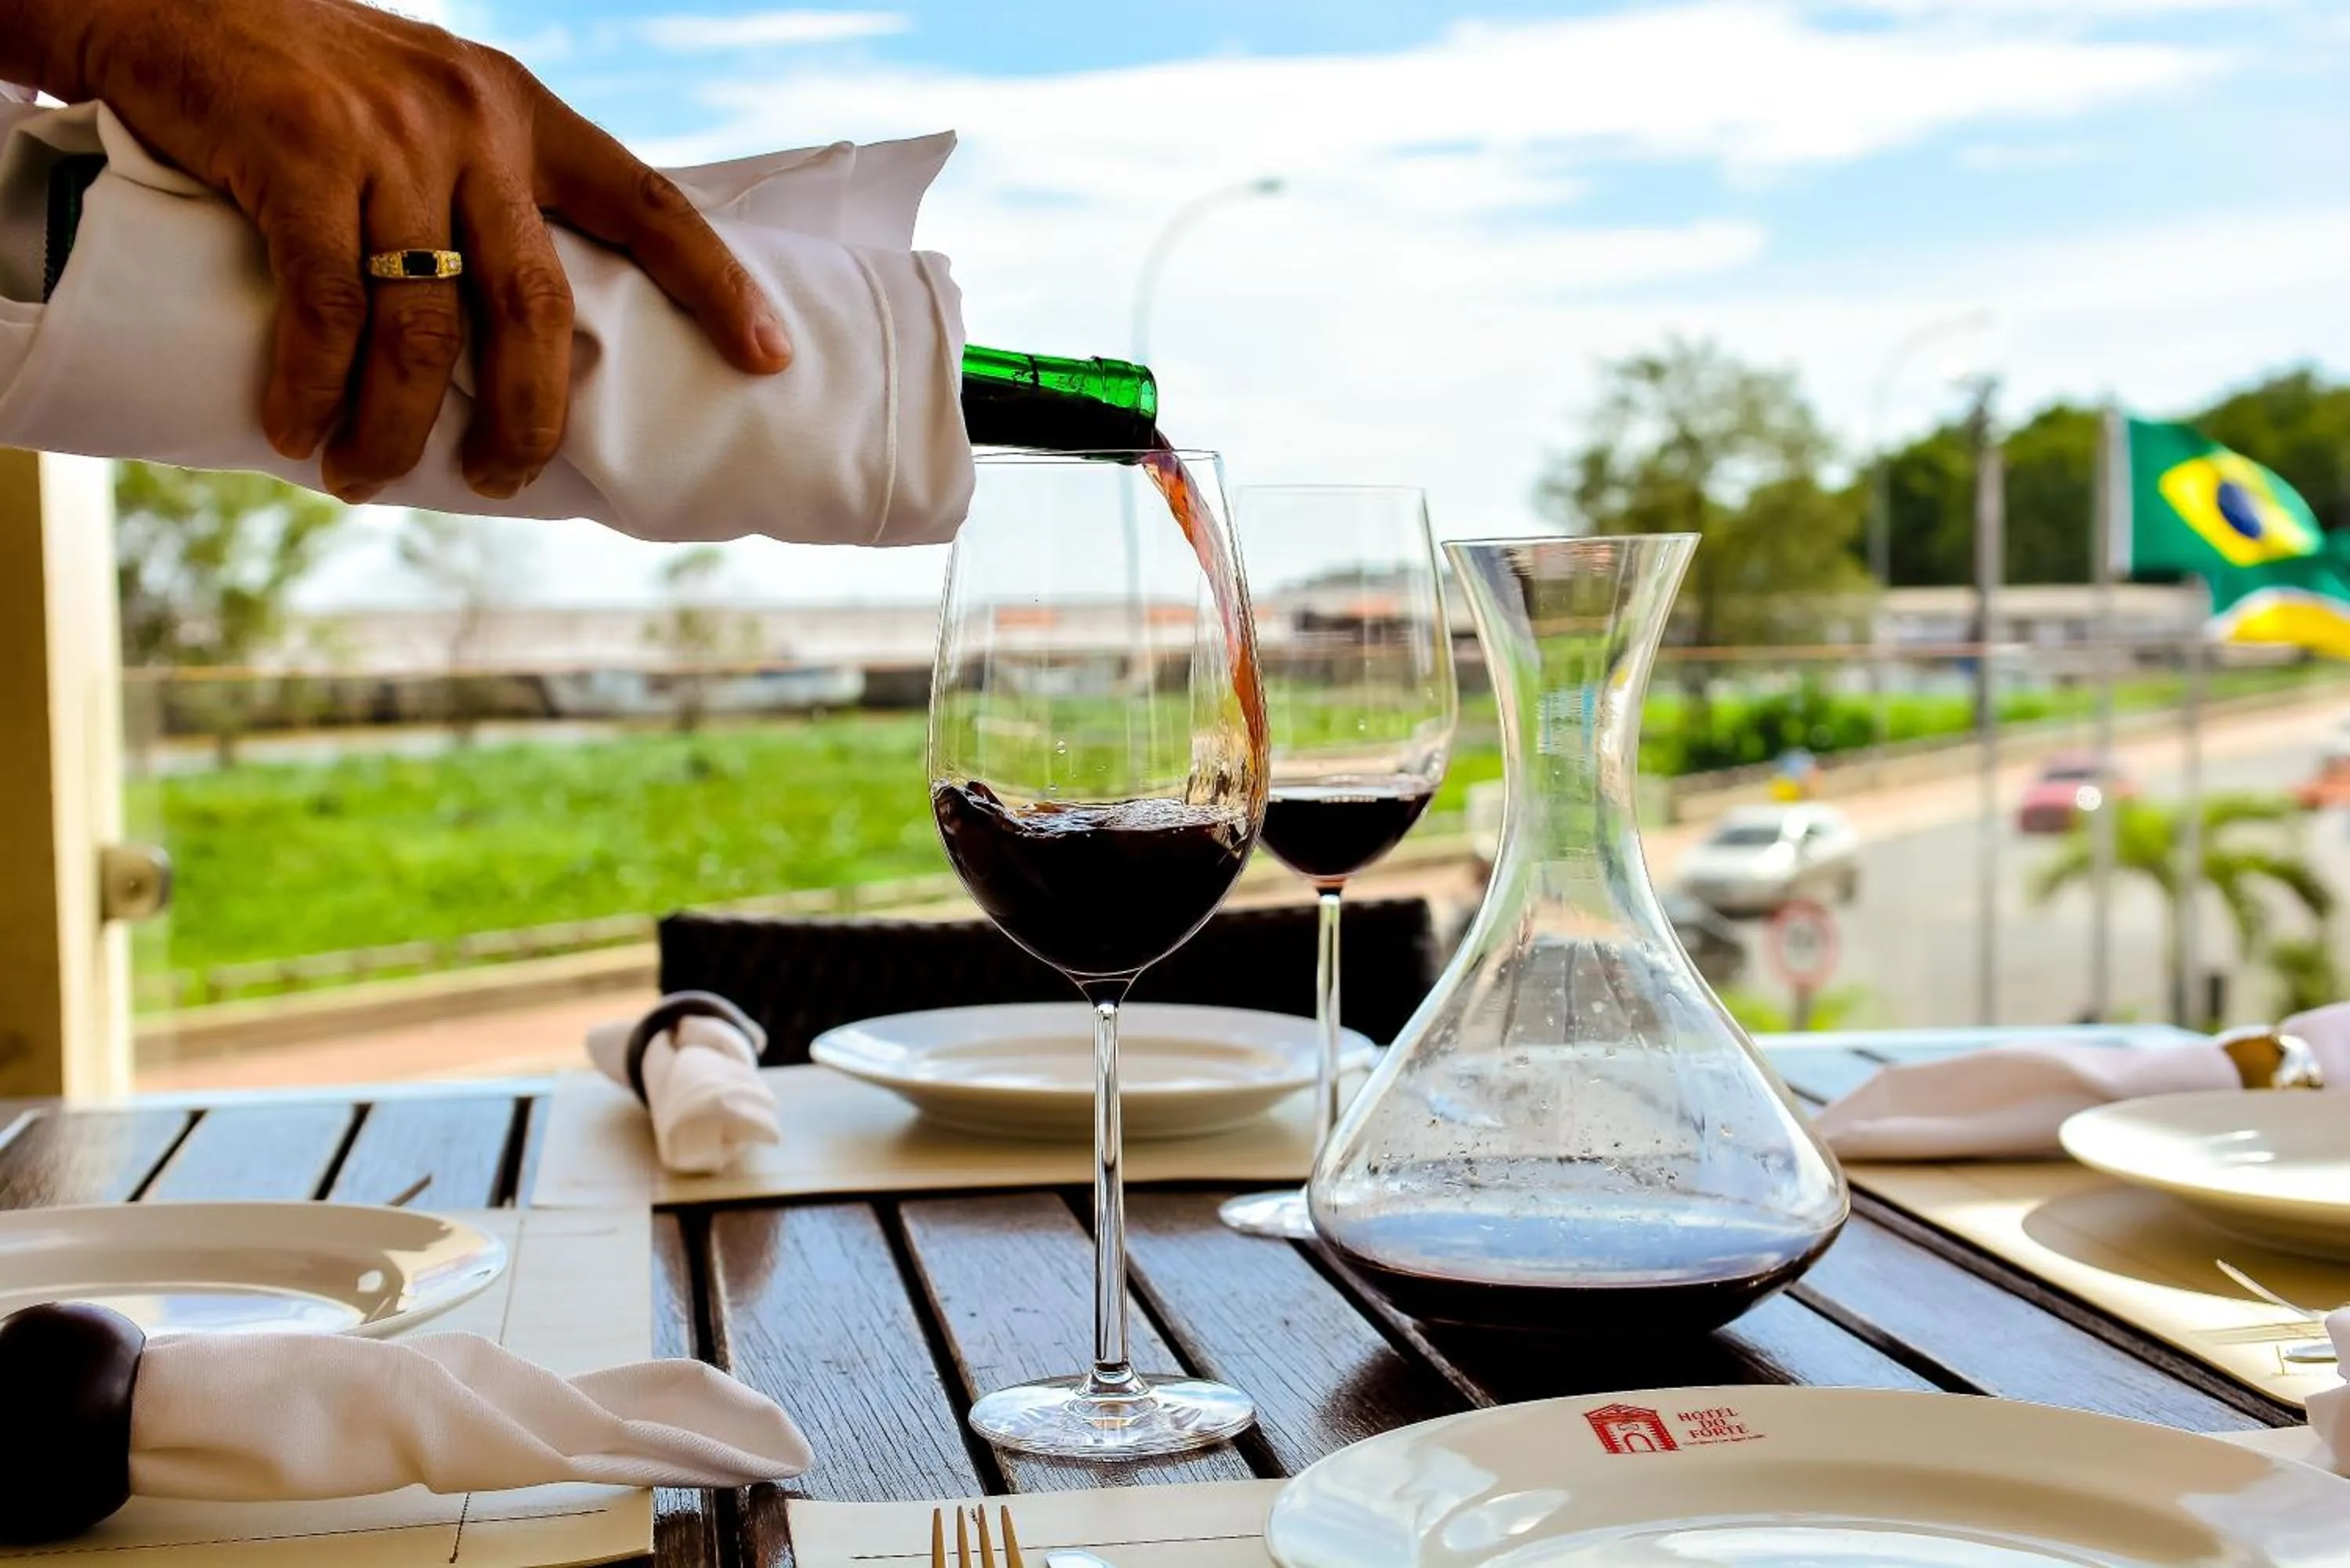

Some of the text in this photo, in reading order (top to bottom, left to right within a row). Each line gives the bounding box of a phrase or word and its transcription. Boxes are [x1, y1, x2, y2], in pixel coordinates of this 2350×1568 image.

[1678, 1407, 1738, 1422] HOTEL
[1699, 1418, 1726, 1428] DO
[1690, 1425, 1749, 1439] FORTE
